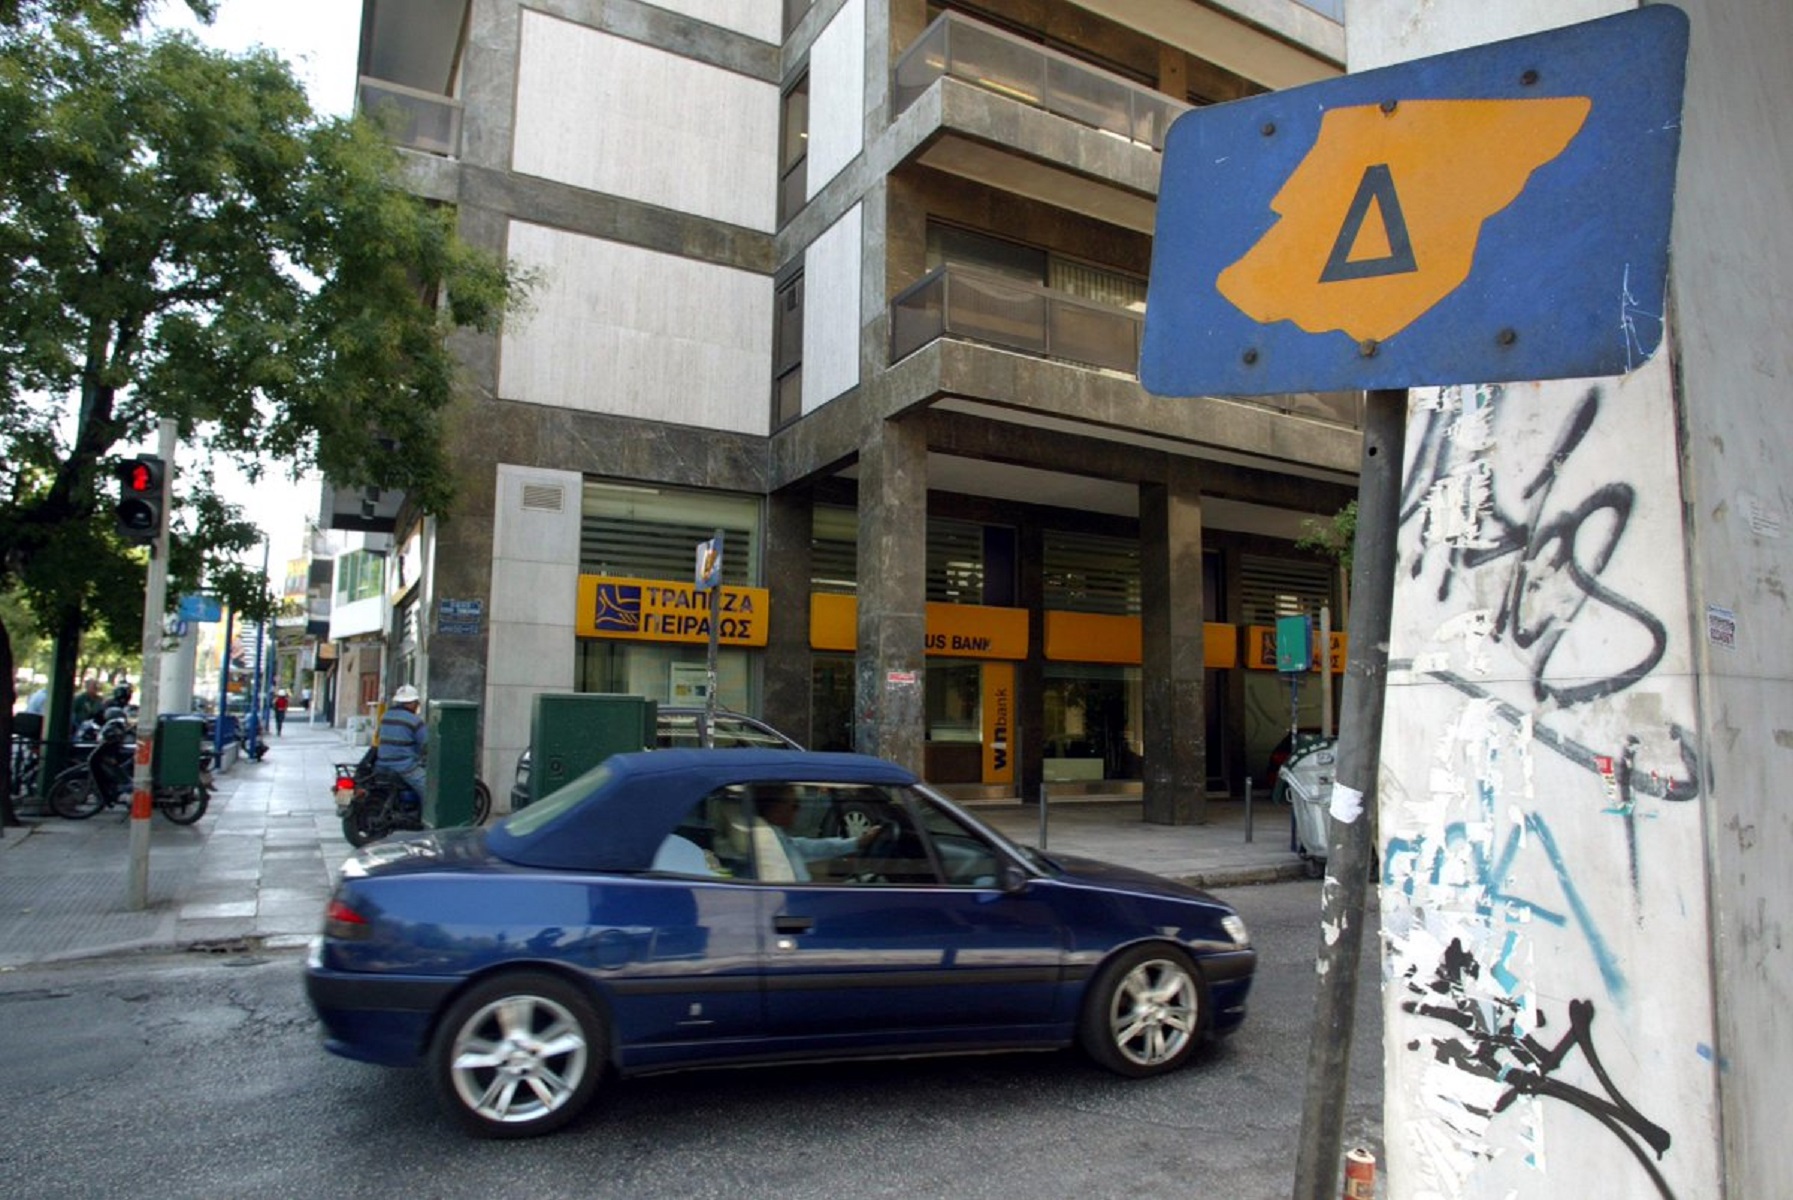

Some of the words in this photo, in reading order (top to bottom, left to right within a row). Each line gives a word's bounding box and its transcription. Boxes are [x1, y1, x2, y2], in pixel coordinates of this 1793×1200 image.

[1318, 163, 1418, 284] Δ
[646, 586, 753, 614] ΤΡΑΠΖΑ
[644, 613, 752, 639] ΠΕΙΡΑΩΣ
[924, 633, 947, 649] US
[951, 635, 992, 651] BANK
[990, 688, 1008, 771] winbank
